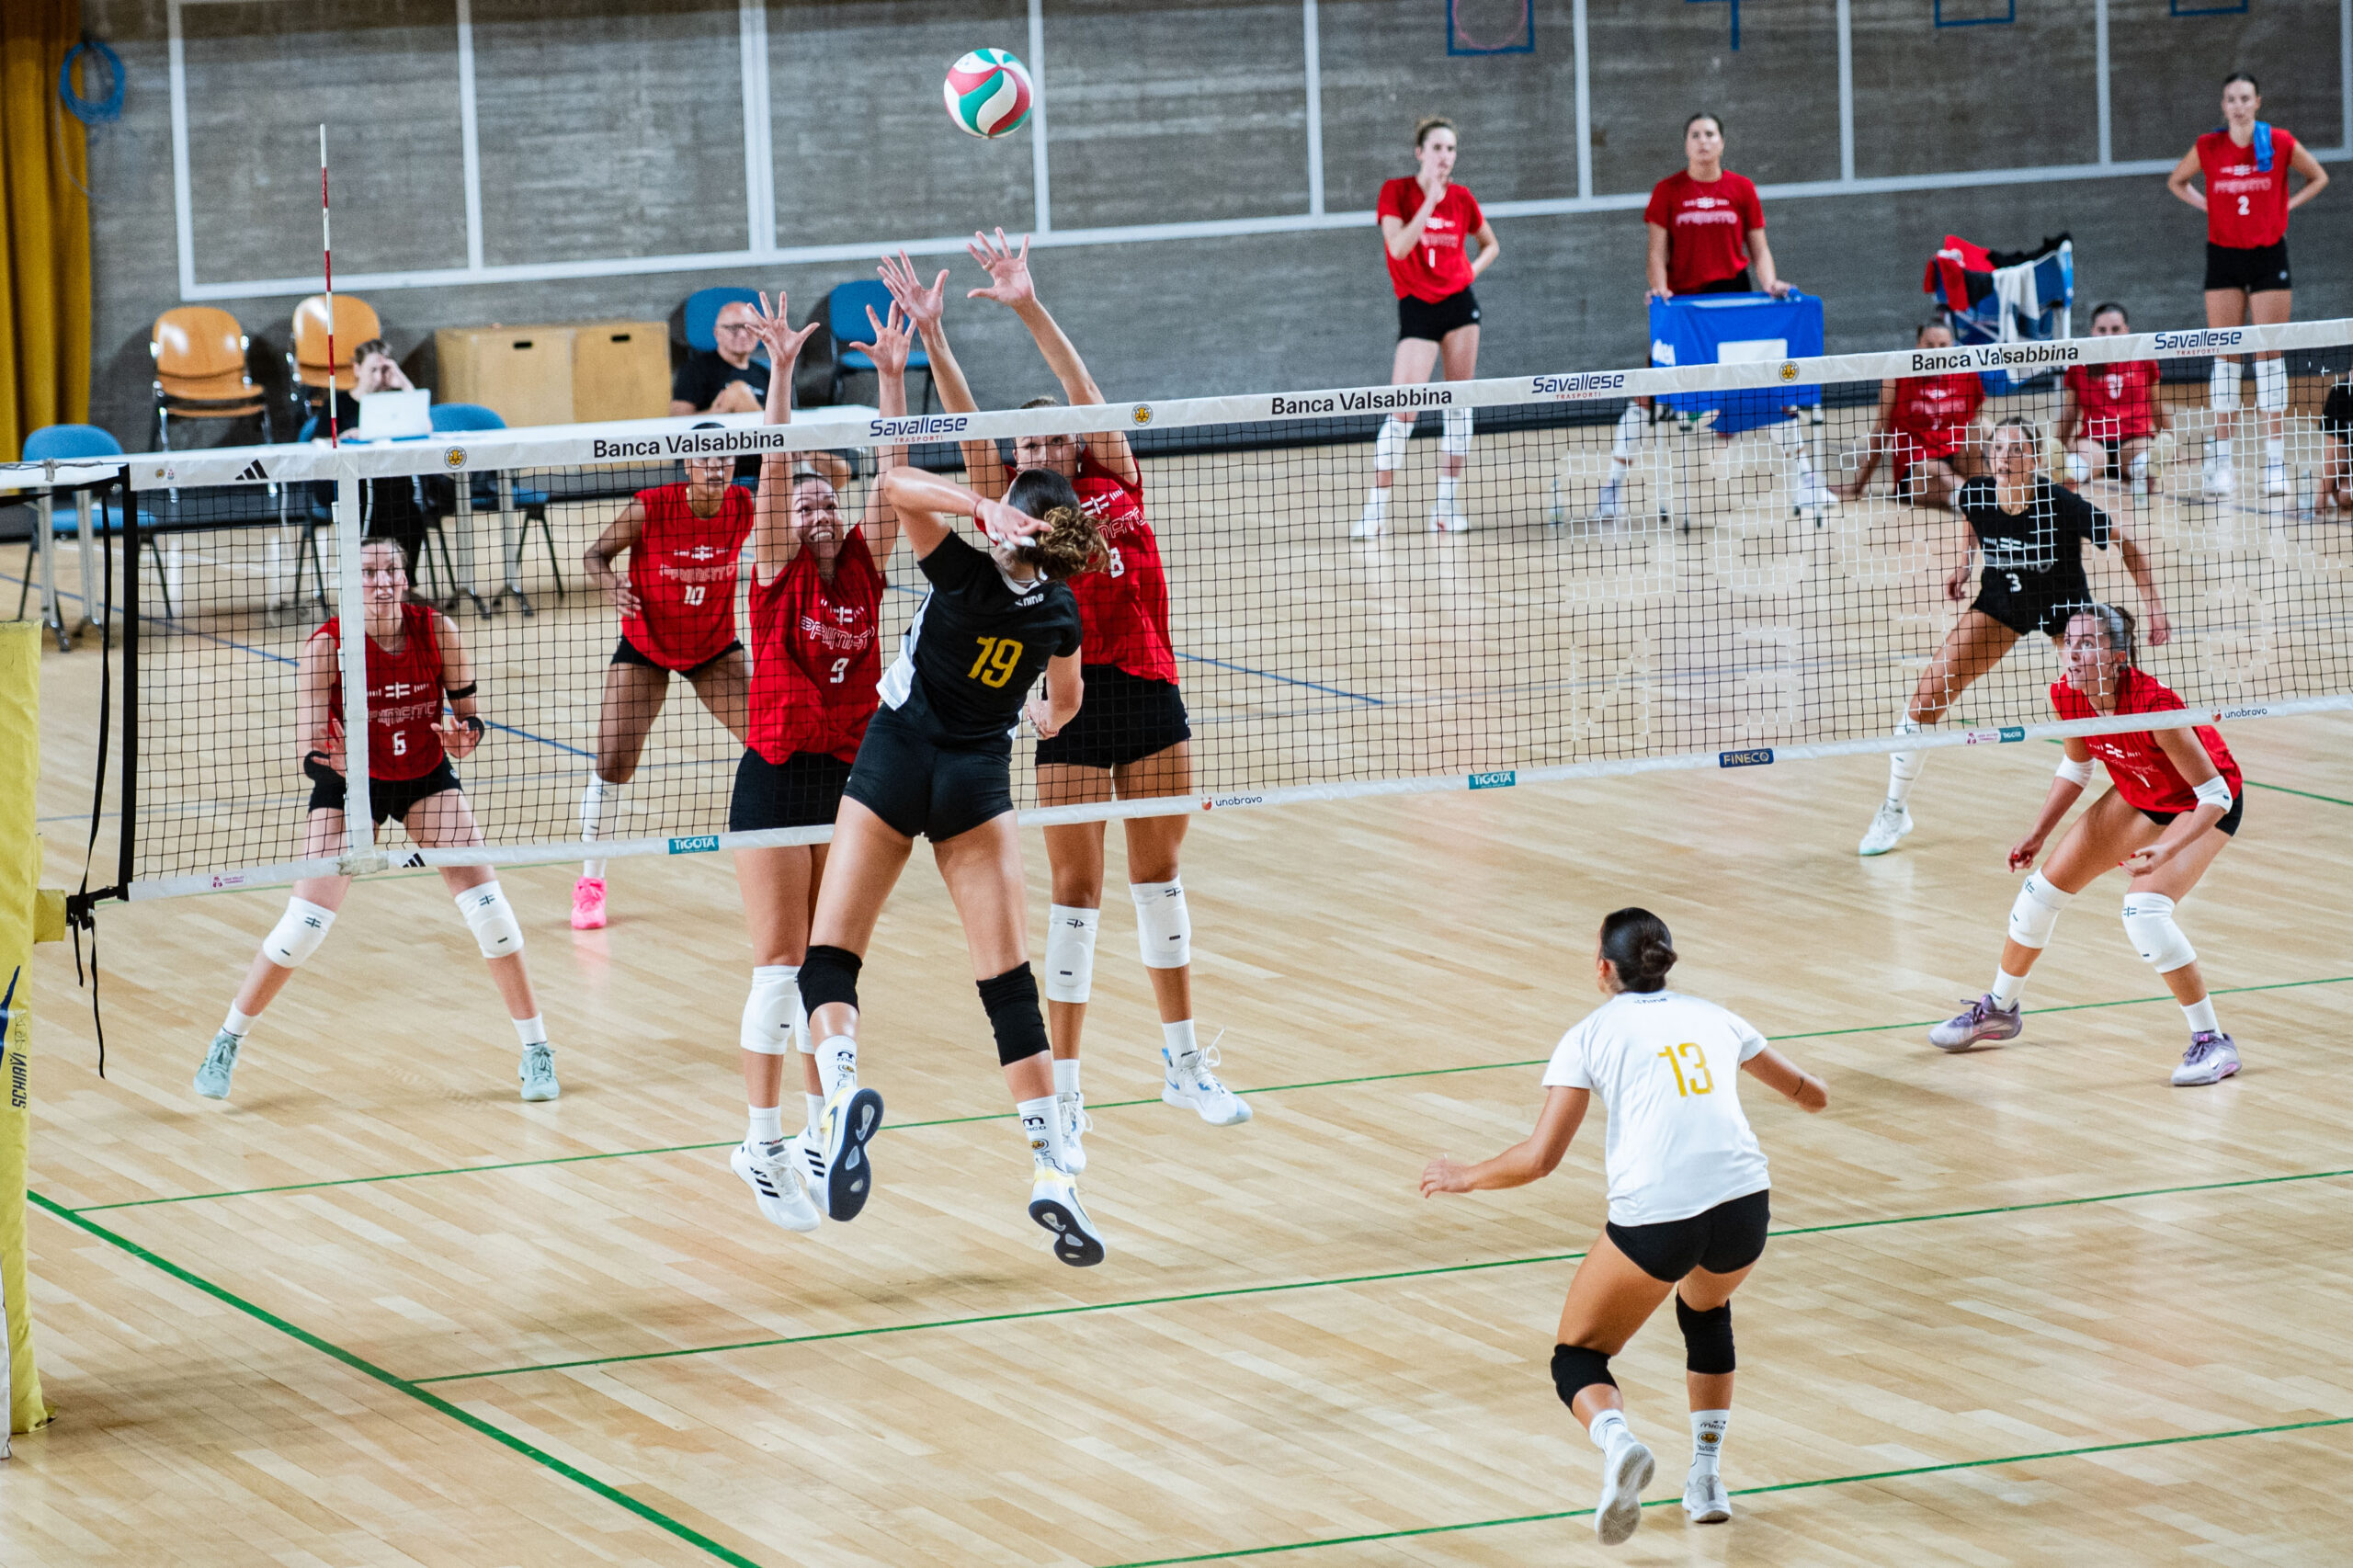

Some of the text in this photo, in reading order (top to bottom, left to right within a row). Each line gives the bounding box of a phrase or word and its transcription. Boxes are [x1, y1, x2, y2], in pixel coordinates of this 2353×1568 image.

[2237, 195, 2250, 215] 2
[1428, 248, 1436, 267] 1
[2154, 331, 2242, 349] Savallese
[1912, 345, 2079, 371] Banca Valsabbina
[1531, 373, 1625, 393] Savallese
[1271, 388, 1452, 415] Banca Valsabbina
[1555, 392, 1601, 400] TRASPORTI
[870, 416, 968, 437] Savallese
[594, 431, 785, 458] Banca Valsabbina
[894, 435, 943, 443] TRASPORTI
[2006, 573, 2021, 593] 3
[684, 585, 706, 607] 10
[967, 636, 1024, 688] 19
[2224, 708, 2268, 719] unobravo
[392, 731, 406, 756] 6
[1723, 752, 1769, 765] FINECO
[1216, 796, 1263, 807] unobravo
[1657, 1042, 1714, 1097] 13
[9, 1051, 28, 1109] SCHIAVI
